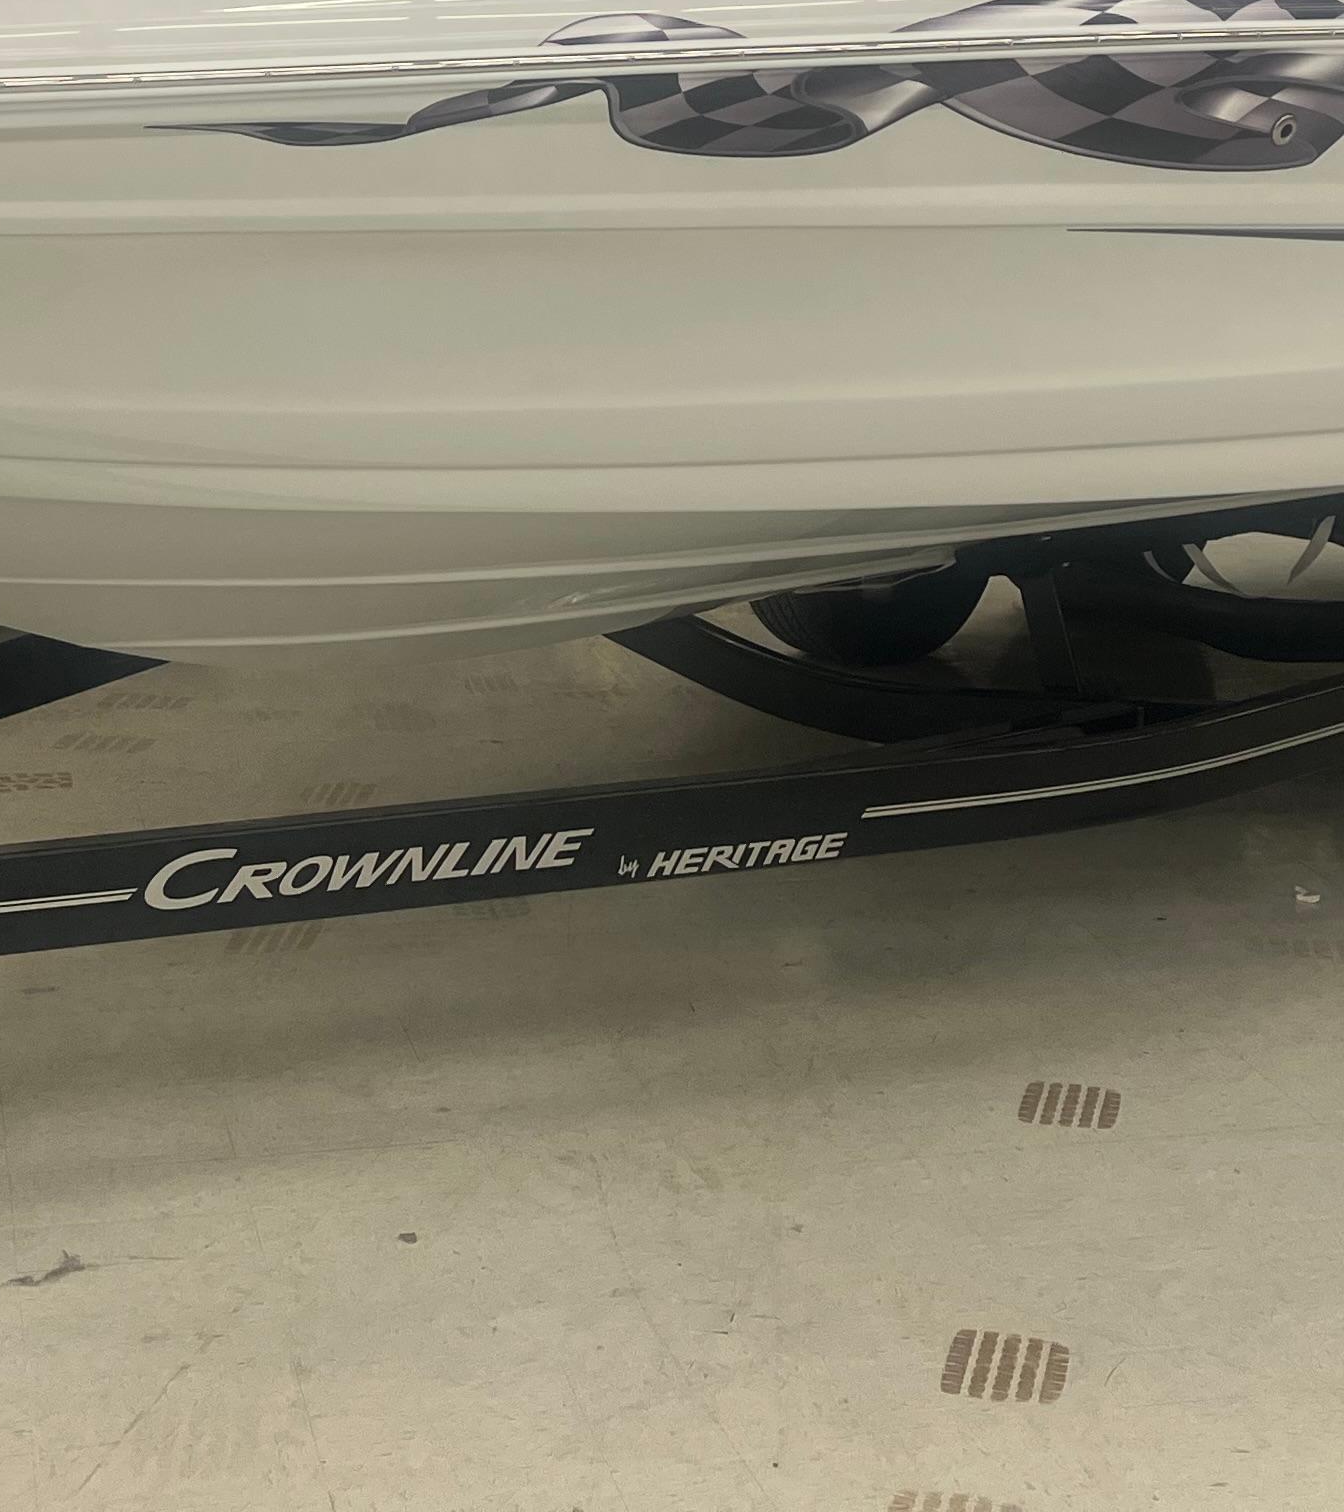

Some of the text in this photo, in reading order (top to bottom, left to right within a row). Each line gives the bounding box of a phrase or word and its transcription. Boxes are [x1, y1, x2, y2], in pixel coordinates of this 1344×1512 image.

[144, 828, 849, 911] CROWNLINE by HERITAGE
